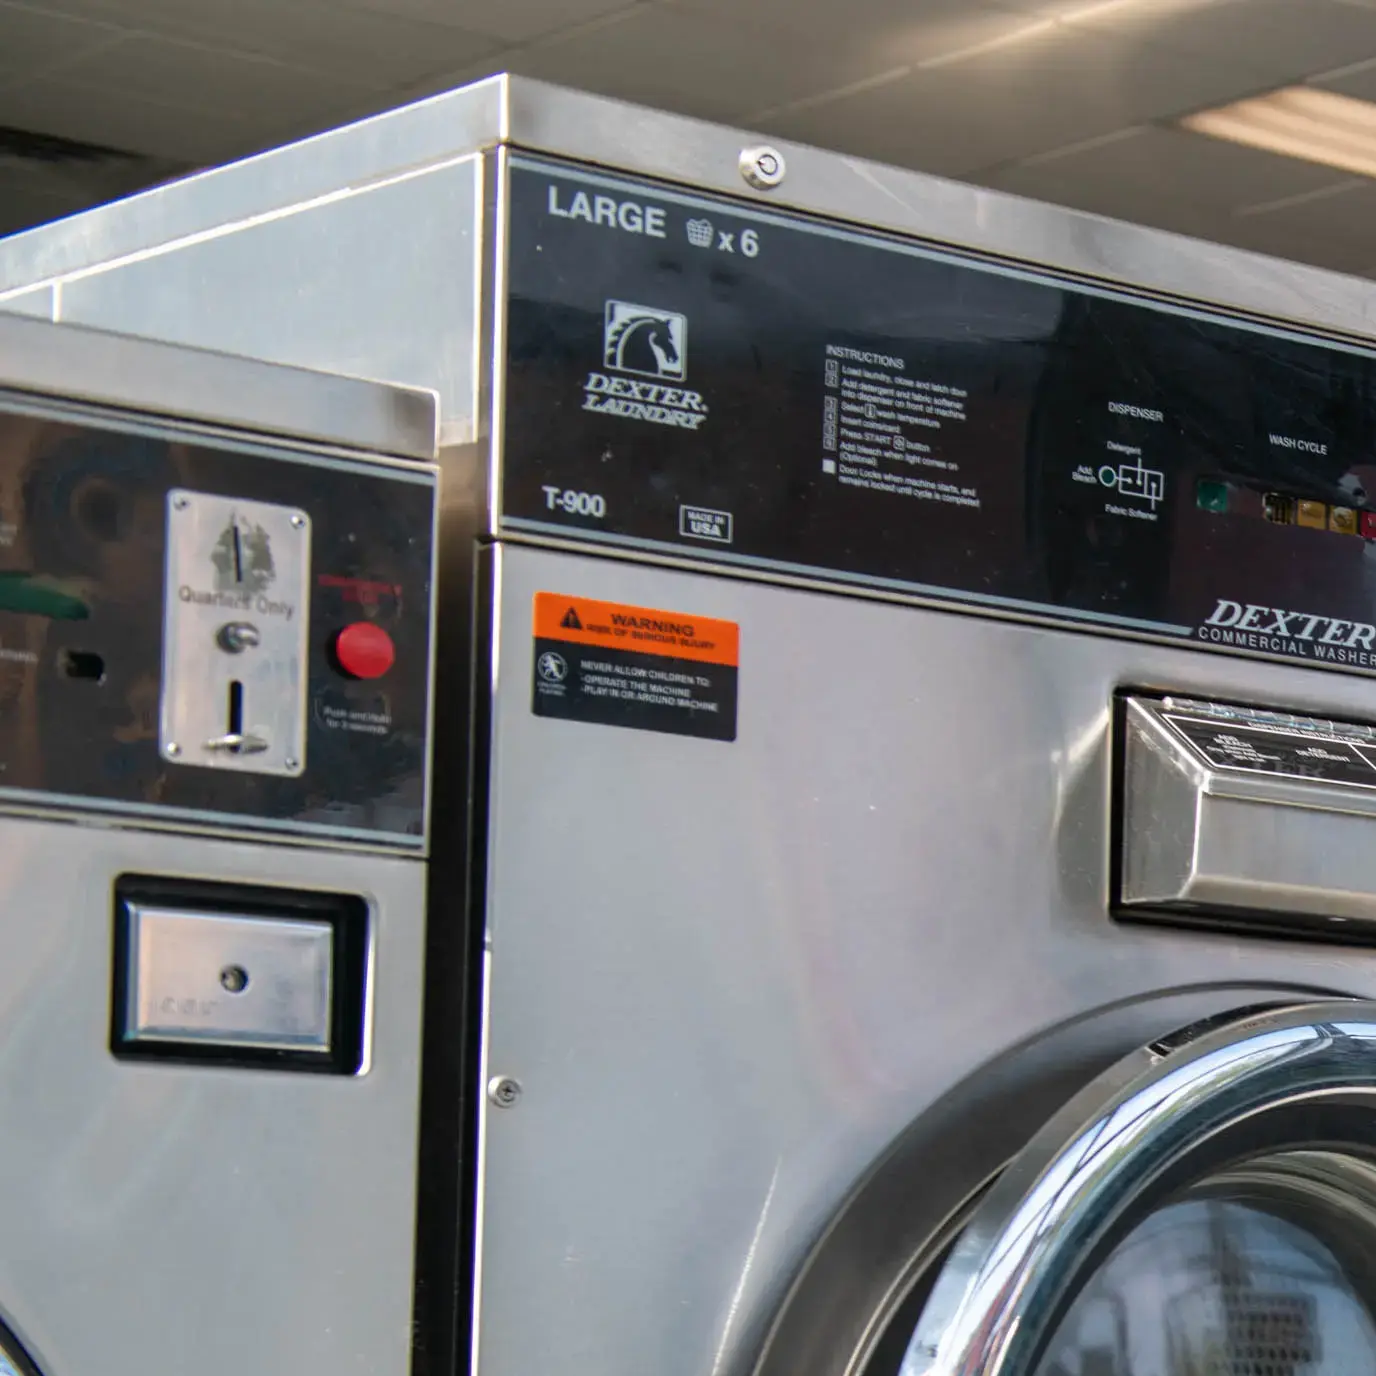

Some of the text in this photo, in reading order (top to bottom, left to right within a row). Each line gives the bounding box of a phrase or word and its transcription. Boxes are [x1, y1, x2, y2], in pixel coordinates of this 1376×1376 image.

[548, 185, 760, 257] LARGE x 6
[826, 344, 905, 369] INSTRUCTIONS
[582, 394, 707, 429] LAUNDRY
[1108, 401, 1164, 422] DISPENSER
[1269, 433, 1328, 456] WASH CYCLE
[542, 485, 606, 518] T-900
[688, 511, 724, 525] MADE IN
[691, 521, 722, 537] USA
[178, 583, 295, 620] Quarters Only
[610, 613, 695, 637] WARNING
[1204, 599, 1376, 650] DEXTER
[1198, 626, 1307, 655] COMMERCIAL
[580, 660, 711, 687] NEVER ALLOW CHILDREN TO:
